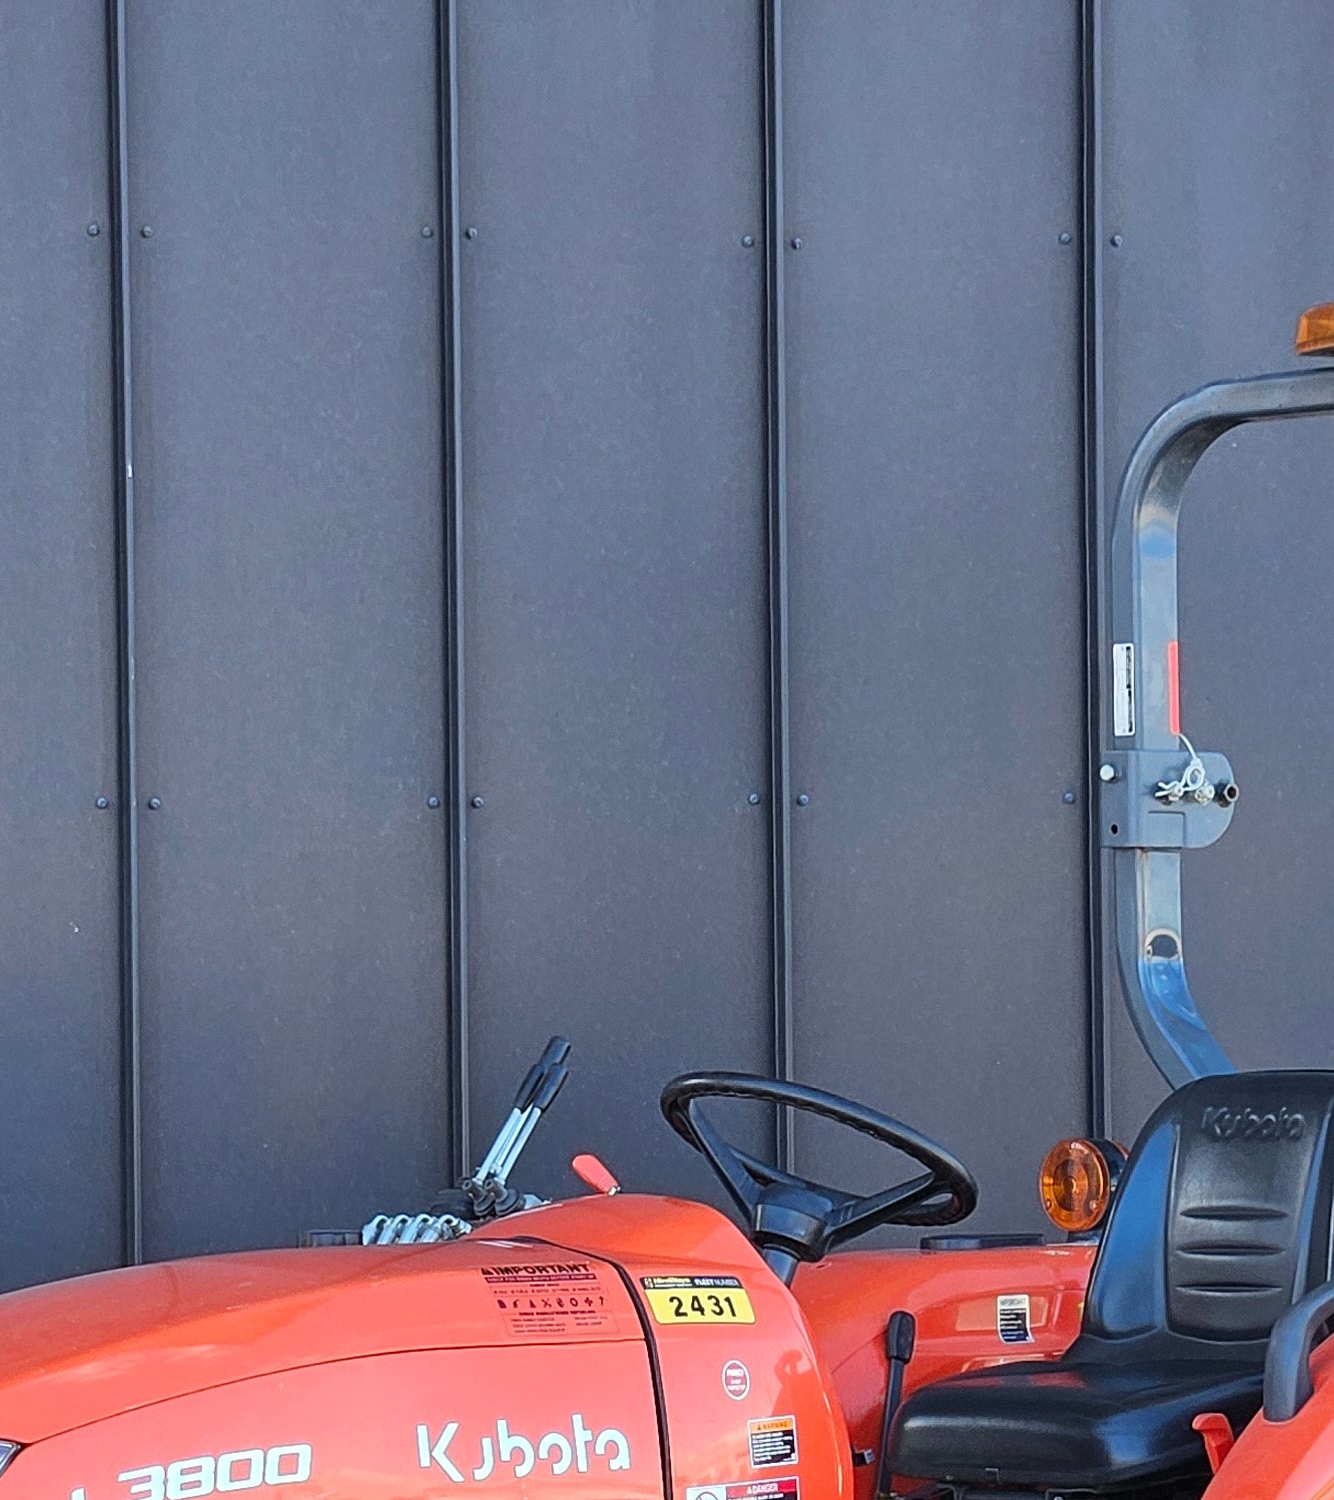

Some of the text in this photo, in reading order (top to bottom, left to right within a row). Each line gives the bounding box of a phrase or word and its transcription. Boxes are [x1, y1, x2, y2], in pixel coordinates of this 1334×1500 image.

[1200, 1106, 1306, 1138] Kubota
[492, 1264, 589, 1275] IMPORTANT
[668, 1294, 737, 1318] 2431
[415, 1412, 632, 1484] Kubota
